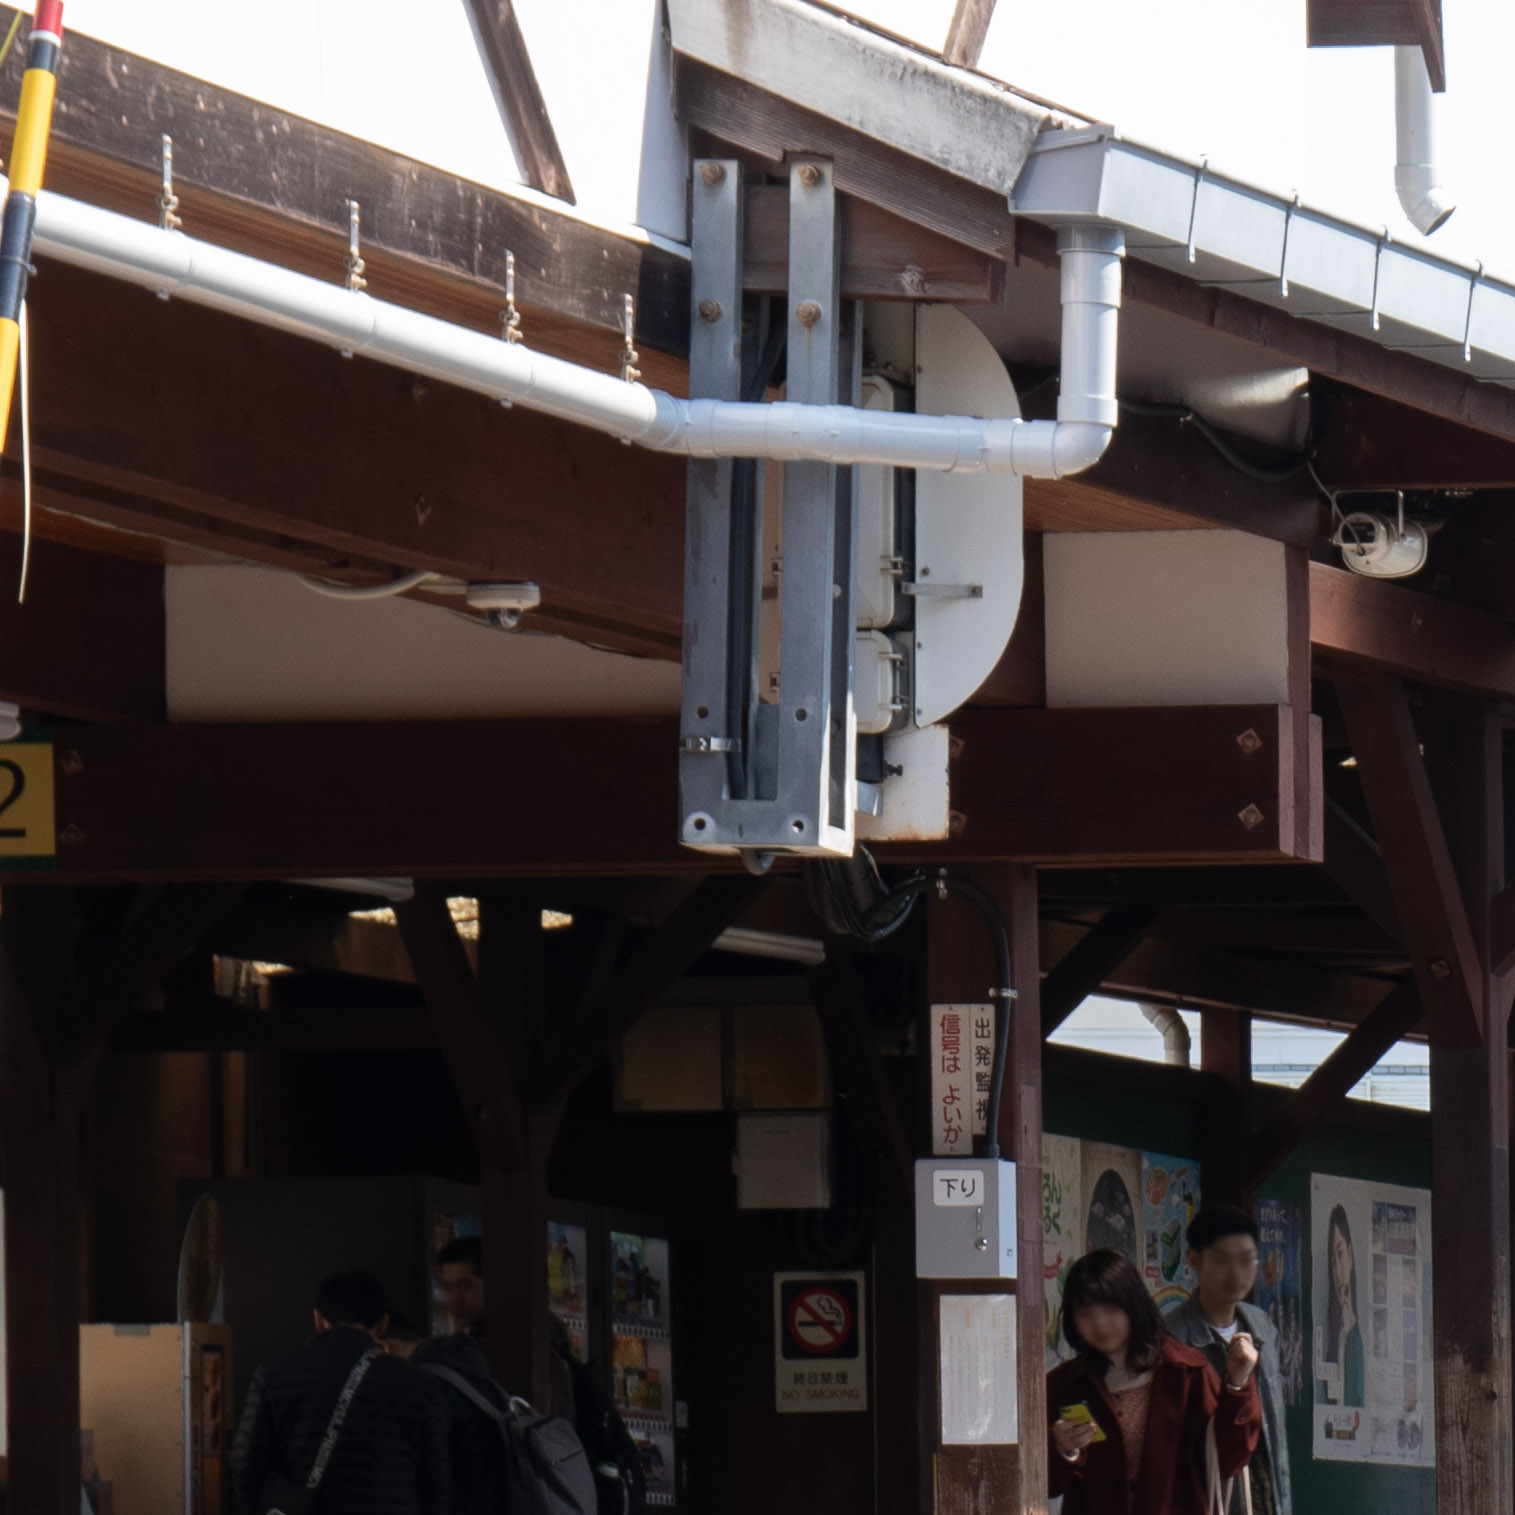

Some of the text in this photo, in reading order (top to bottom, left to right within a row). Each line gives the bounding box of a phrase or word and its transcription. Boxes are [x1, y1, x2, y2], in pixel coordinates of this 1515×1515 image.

[939, 1177, 977, 1199] 下り
[782, 1388, 860, 1401] NO SMOKING
